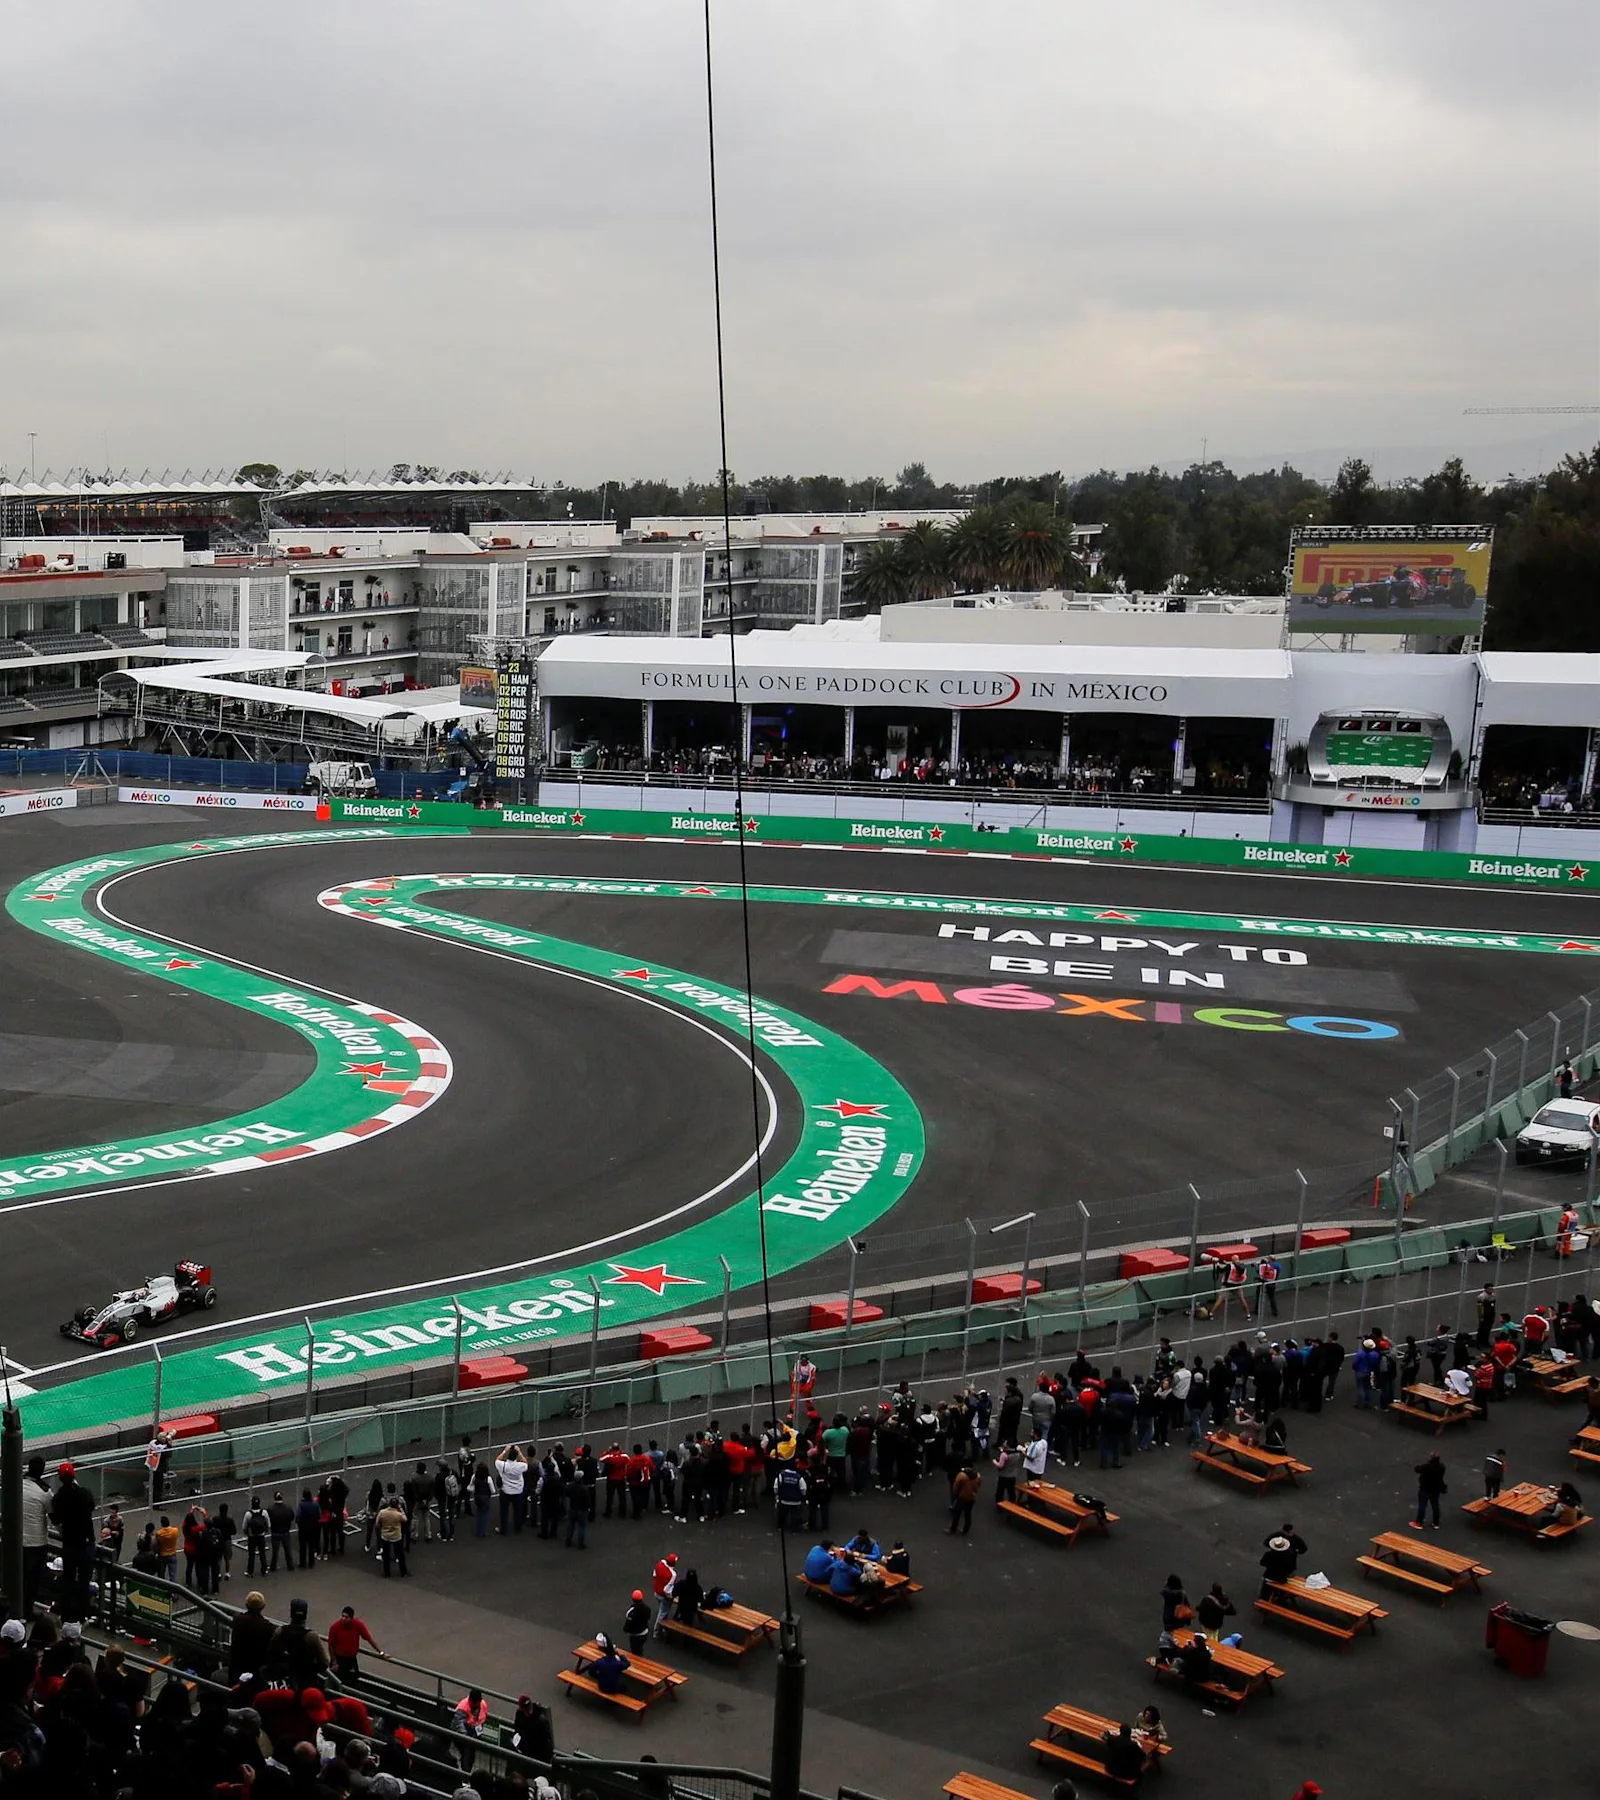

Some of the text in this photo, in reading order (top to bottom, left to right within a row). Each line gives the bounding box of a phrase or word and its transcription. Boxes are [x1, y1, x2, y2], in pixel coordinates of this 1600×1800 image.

[508, 662, 519, 673] 23
[500, 674, 508, 684] 01
[511, 674, 529, 685] HAM
[641, 672, 1168, 702] FORMULA ONE PADDOCK CLUB IN MÉXICO
[500, 686, 527, 697] 02 PER
[499, 697, 526, 709] 03 HUL
[498, 709, 527, 720] 04 ROS
[498, 721, 523, 731] 05 RIC
[498, 732, 525, 744] 06 BOT
[497, 744, 525, 755] 07 KVY
[496, 756, 525, 767] 08 GRO
[496, 767, 525, 778] 09 MAS
[343, 803, 404, 817] Heineken
[502, 809, 566, 825] Heineken
[851, 823, 923, 840] Heineken
[1037, 833, 1114, 851] Heineken
[1244, 846, 1327, 866] Heineken
[1469, 859, 1560, 880] Heineken
[430, 878, 657, 893] Heineken
[823, 893, 1068, 917] Heineken
[42, 917, 160, 960] Heineken
[1237, 919, 1522, 948] Heineken
[938, 922, 1309, 966] HAPPY TO
[988, 955, 1227, 990] BE IN
[248, 991, 386, 1056] Heineken
[758, 1125, 887, 1222] Heineken
[215, 1284, 616, 1382] Heineken
